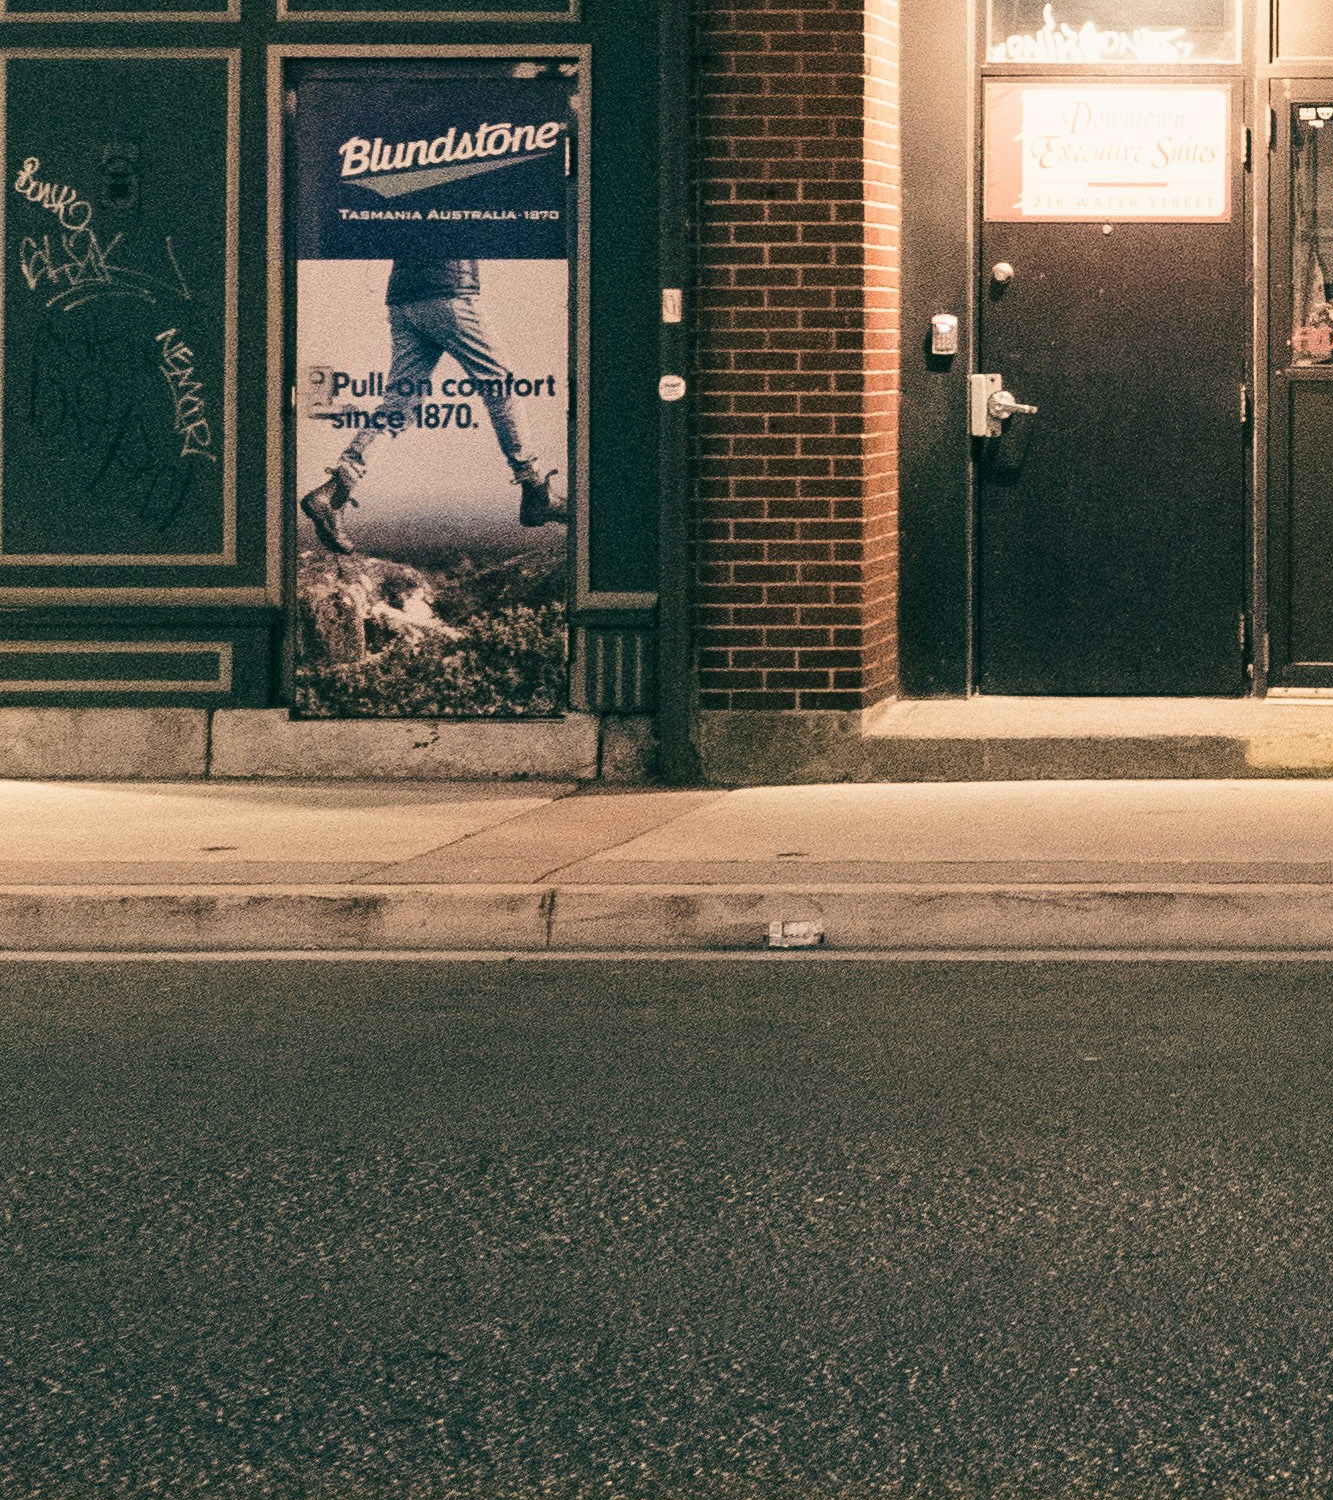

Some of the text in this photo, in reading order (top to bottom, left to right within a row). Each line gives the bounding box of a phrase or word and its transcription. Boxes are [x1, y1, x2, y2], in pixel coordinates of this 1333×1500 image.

[1062, 101, 1185, 135] Downtown
[339, 122, 560, 177] Blundstone
[1030, 135, 1218, 170] Executive Suites
[338, 208, 423, 221] TASMANIA
[1076, 195, 1138, 209] WATER
[1148, 195, 1215, 209] STREET
[441, 372, 556, 397] comfort
[331, 404, 480, 430] since 1870.
